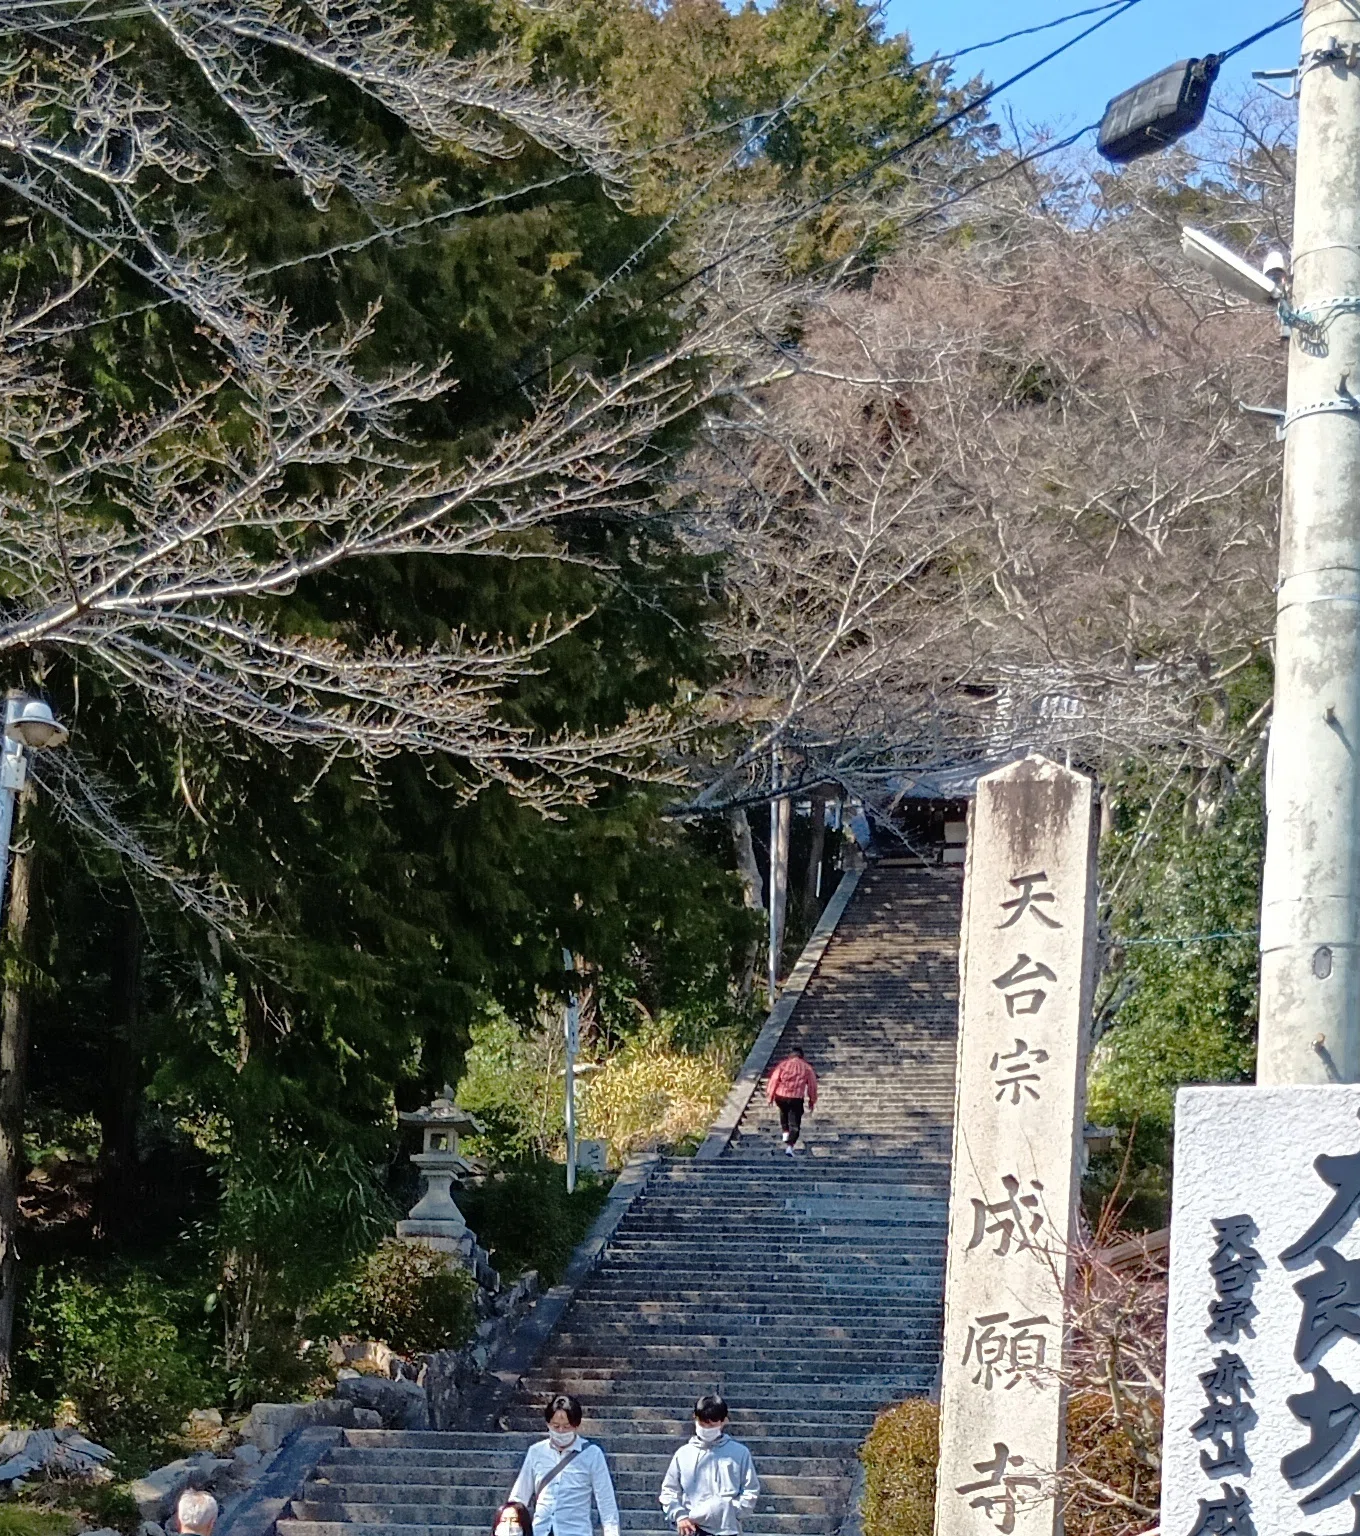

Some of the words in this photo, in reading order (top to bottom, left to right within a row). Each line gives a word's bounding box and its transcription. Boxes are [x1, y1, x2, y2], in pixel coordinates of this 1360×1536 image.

[988, 869, 1064, 1106] 天台宗
[955, 1177, 1048, 1535] 成願寺
